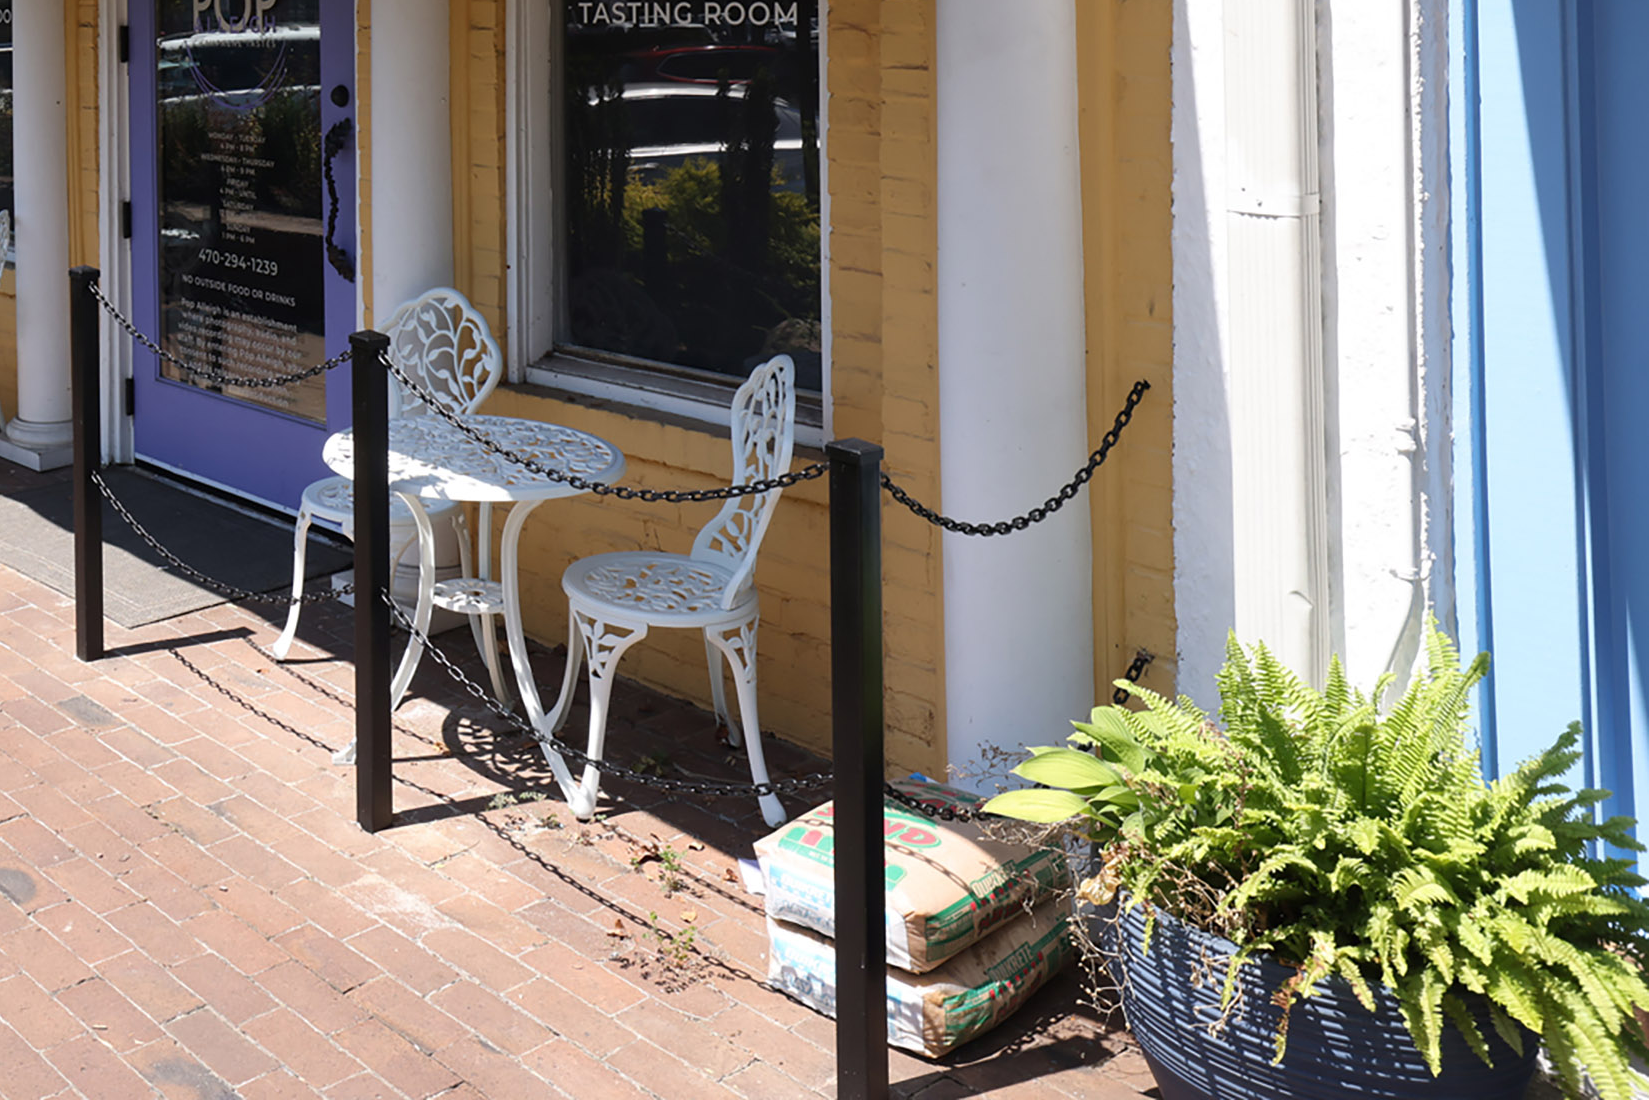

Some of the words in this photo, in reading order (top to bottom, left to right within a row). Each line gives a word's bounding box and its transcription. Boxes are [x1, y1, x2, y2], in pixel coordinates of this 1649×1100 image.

[193, 16, 277, 33] ALLEIGH
[578, 2, 692, 25] TASTING
[704, 2, 798, 26] ROOM
[198, 248, 279, 276] 470-294-1239
[181, 273, 194, 285] NO
[194, 276, 227, 293] OUTSIDE
[228, 283, 250, 297] FOOD
[251, 289, 263, 300] OR
[264, 291, 296, 308] DRINKS
[241, 313, 297, 333] establishment
[988, 944, 1034, 982] QUIKRETE
